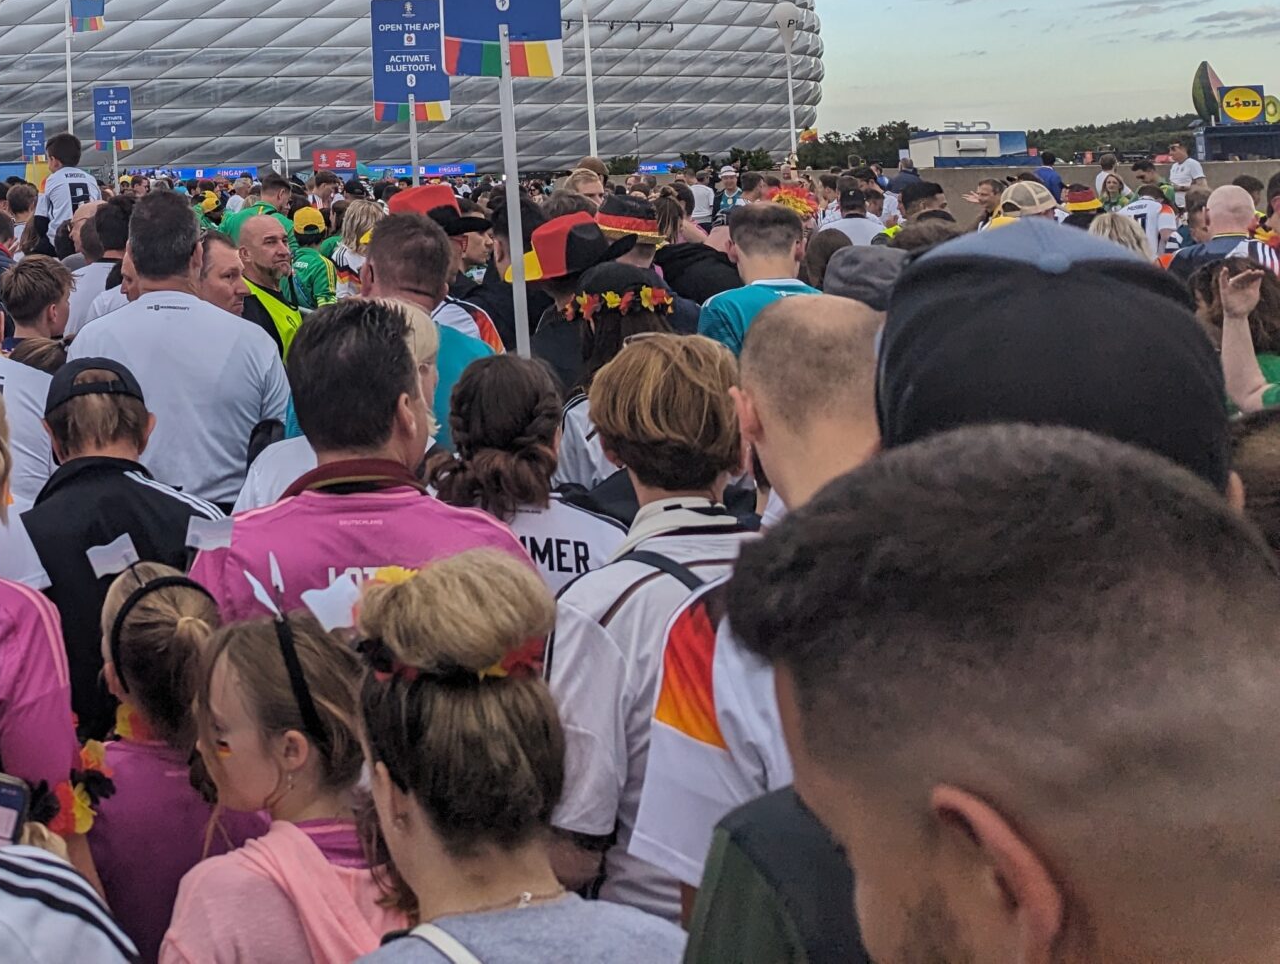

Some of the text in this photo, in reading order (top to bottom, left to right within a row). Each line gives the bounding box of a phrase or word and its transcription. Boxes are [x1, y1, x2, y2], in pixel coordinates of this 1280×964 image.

[404, 23, 421, 31] THE
[422, 23, 440, 31] APP
[389, 55, 430, 63] ACTIVATE
[385, 64, 437, 72] BLUETOOTH
[944, 121, 991, 131] BYD
